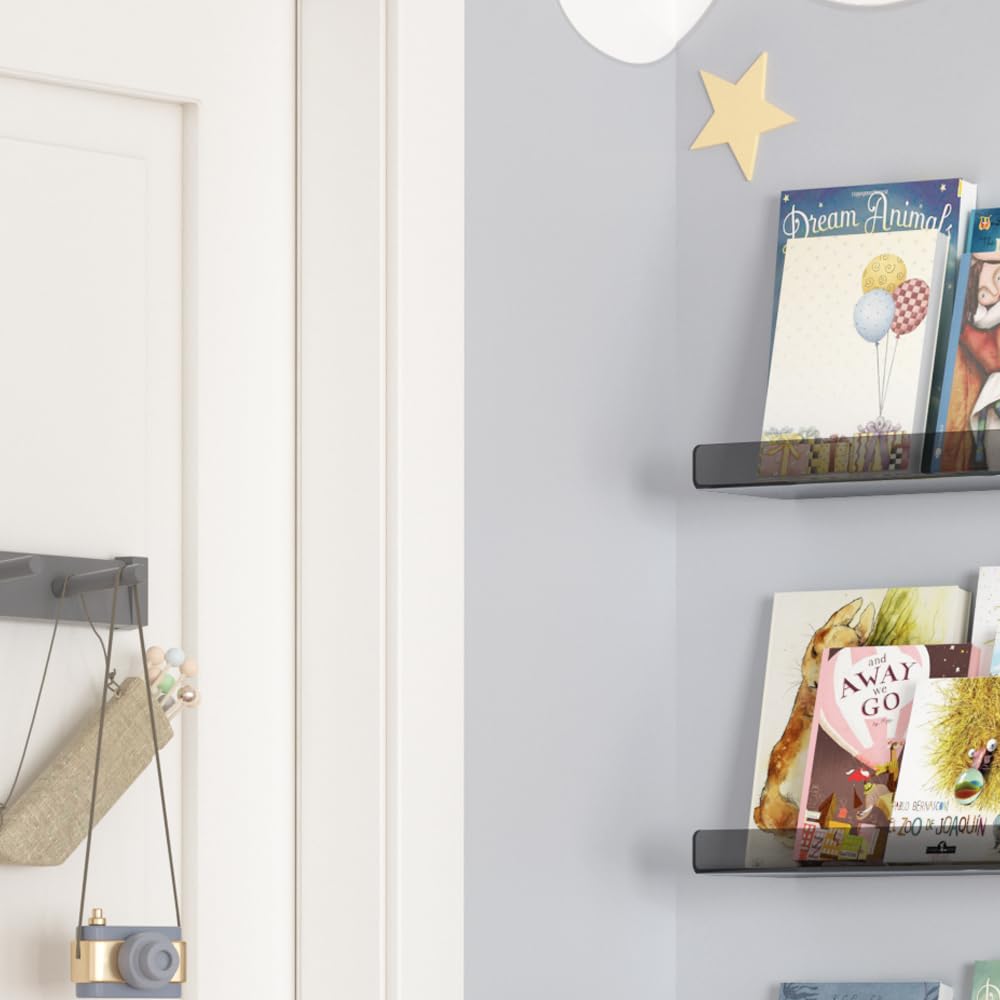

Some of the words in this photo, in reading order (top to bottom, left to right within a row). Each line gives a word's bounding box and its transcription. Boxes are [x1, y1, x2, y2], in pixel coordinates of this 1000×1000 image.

[783, 204, 859, 239] Dream
[868, 653, 887, 666] and
[840, 661, 917, 700] AWAY
[873, 686, 888, 696] we
[861, 692, 901, 717] GO
